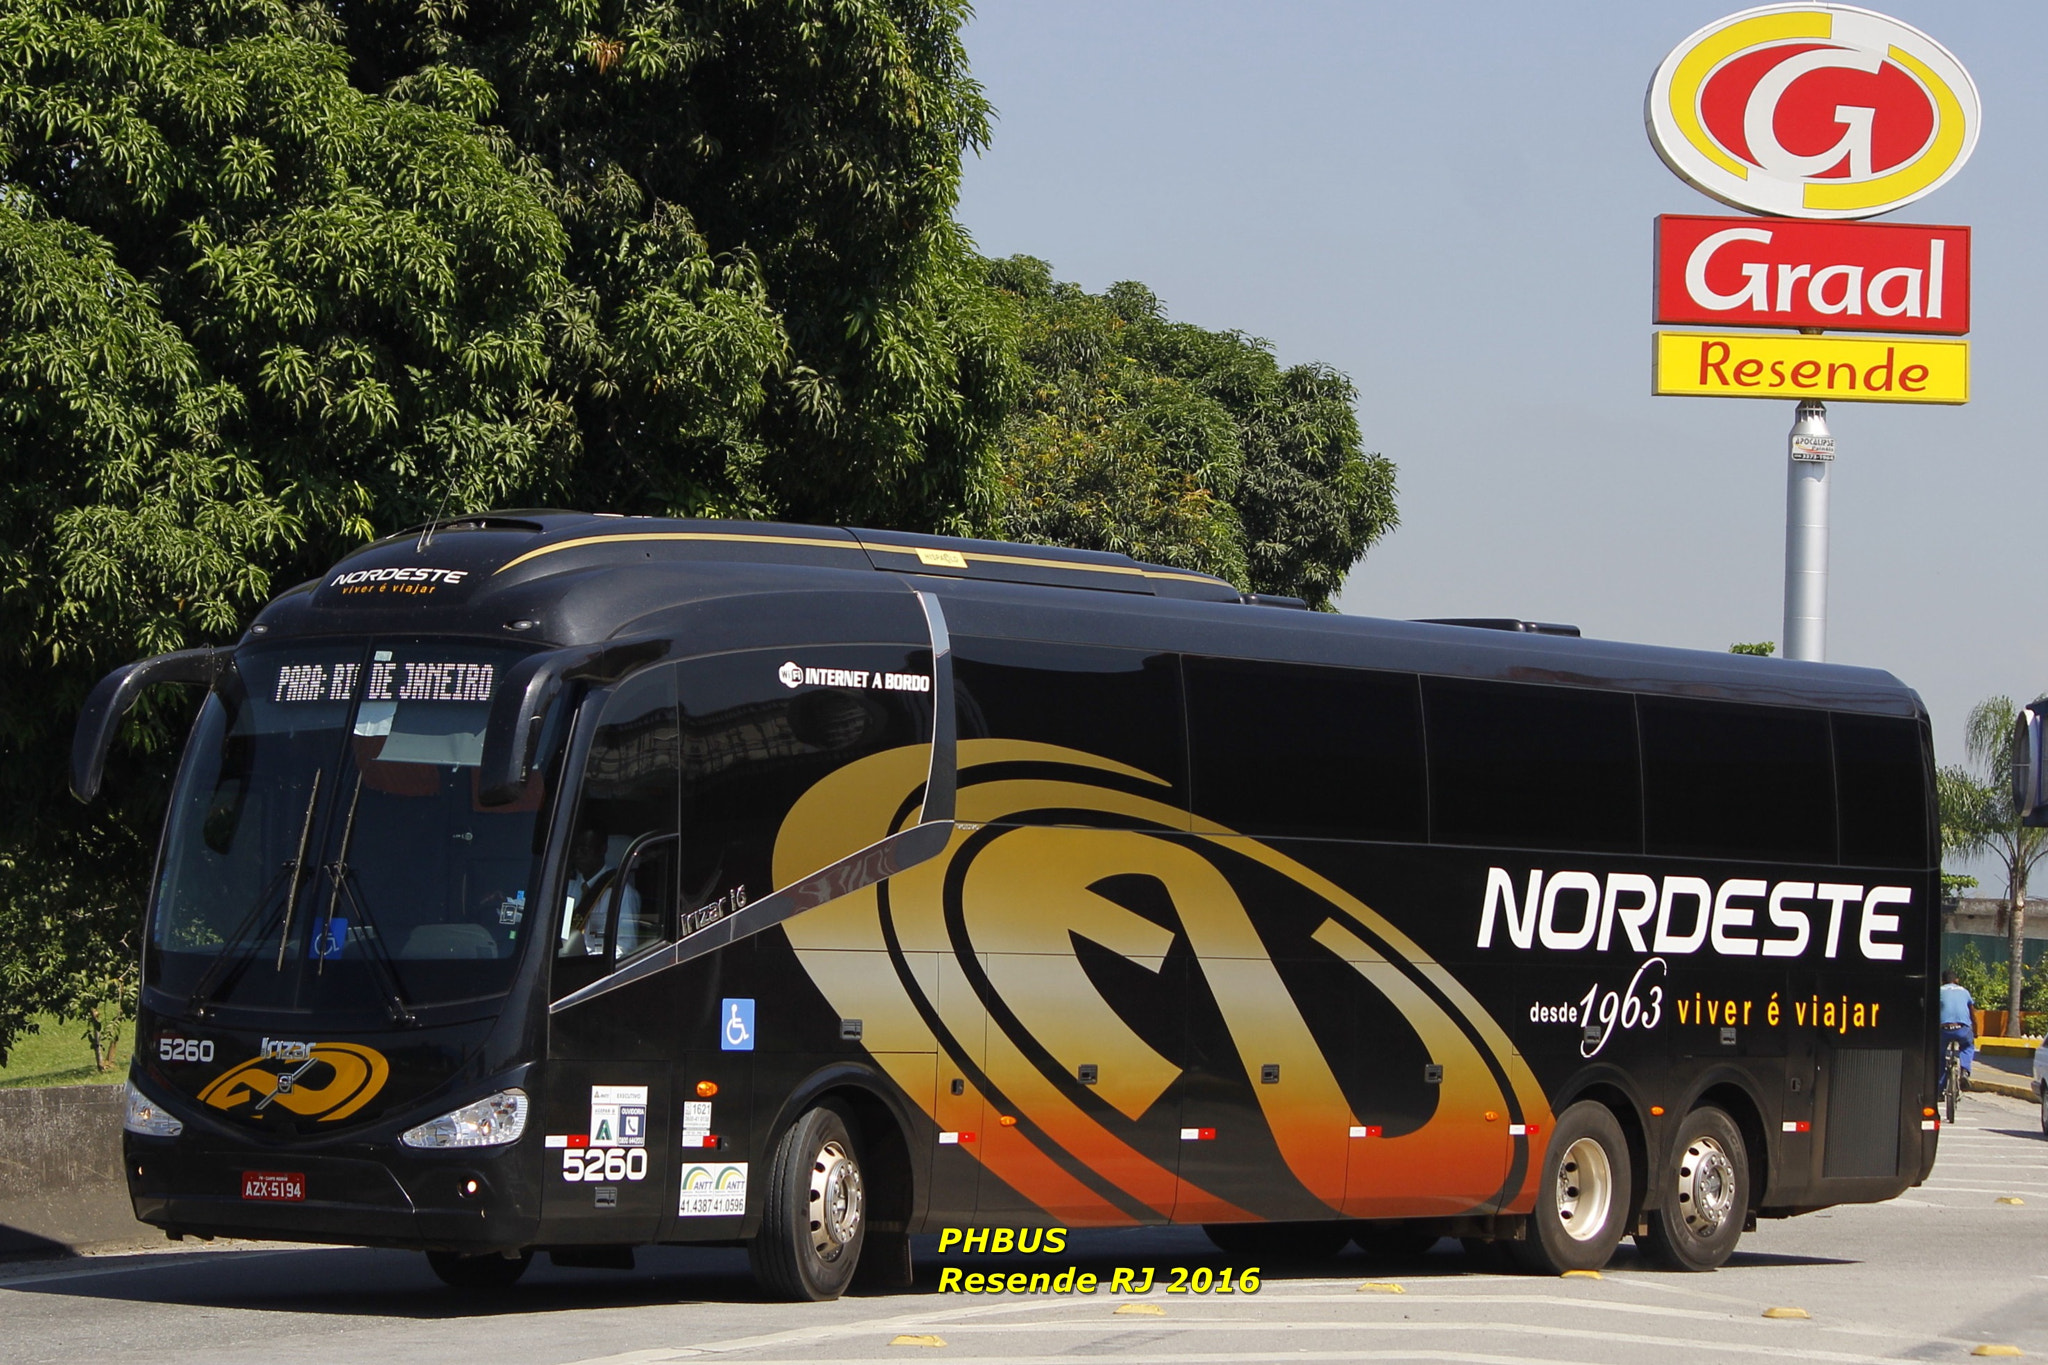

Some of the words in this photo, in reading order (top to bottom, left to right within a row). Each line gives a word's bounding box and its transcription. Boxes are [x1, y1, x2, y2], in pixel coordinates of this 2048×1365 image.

[1685, 227, 1945, 319] Graal
[1699, 341, 1930, 392] Resende
[1795, 437, 1834, 446] APOCALIPSE
[330, 567, 468, 587] NORDESTE
[342, 584, 374, 595] viver
[392, 583, 436, 595] viajar
[368, 663, 397, 699] DE
[400, 663, 494, 701] JANEIRO
[805, 667, 869, 689] INTERNET
[871, 672, 883, 689] A
[884, 673, 930, 693] BORDO
[1477, 867, 1912, 960] NORDESTE
[1529, 1001, 1578, 1023] desde
[1579, 957, 1667, 1058] 1963
[1677, 993, 1752, 1026] viver
[1767, 992, 1779, 1024] é
[1796, 995, 1881, 1034] viajar
[159, 1038, 215, 1062] 5260
[693, 1104, 710, 1114] 1621
[563, 1148, 648, 1182] 5260
[694, 1181, 713, 1190] ANTT
[726, 1181, 745, 1190] ANTT
[680, 1199, 712, 1213] 41.4387
[713, 1198, 744, 1212] 41.0596
